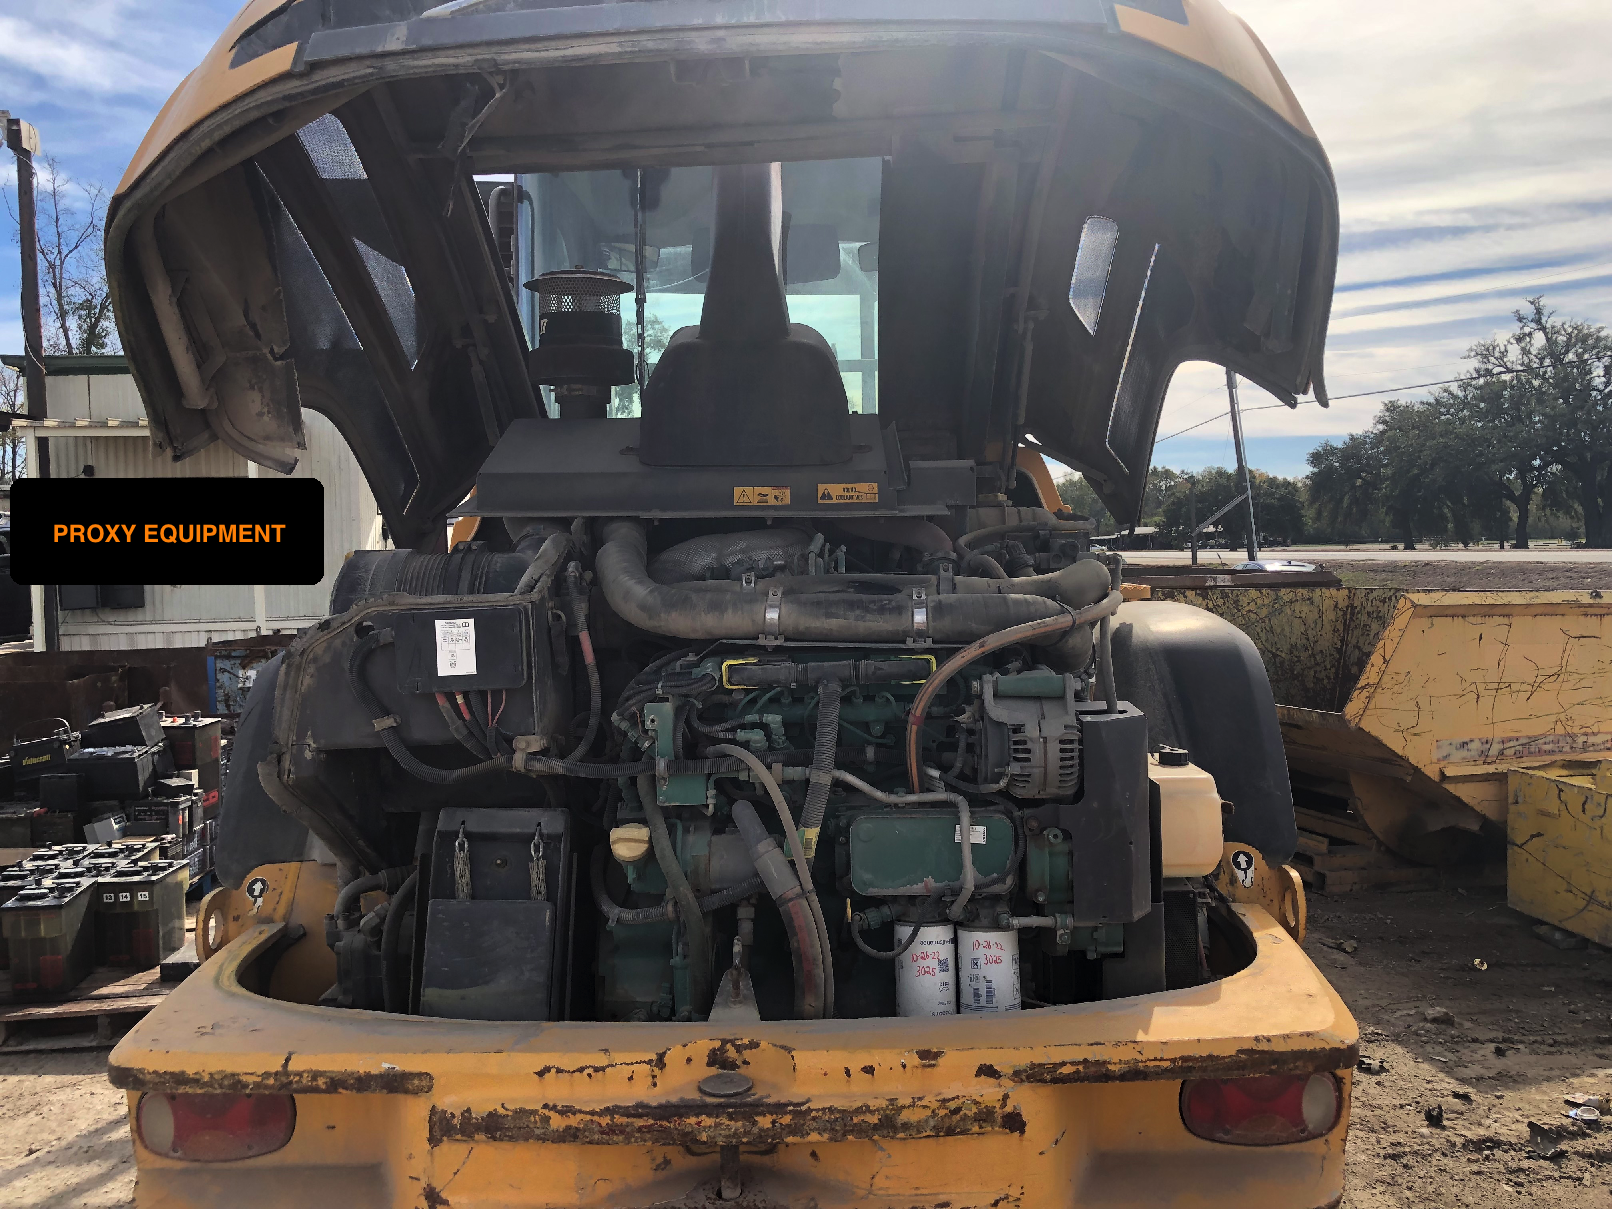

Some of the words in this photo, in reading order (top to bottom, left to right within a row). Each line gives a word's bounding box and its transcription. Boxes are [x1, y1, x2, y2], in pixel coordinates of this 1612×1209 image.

[972, 939, 1006, 951] 10-26-22
[911, 950, 942, 963] 10-26-22
[983, 953, 1003, 966] 3025
[915, 965, 937, 978] 3025
